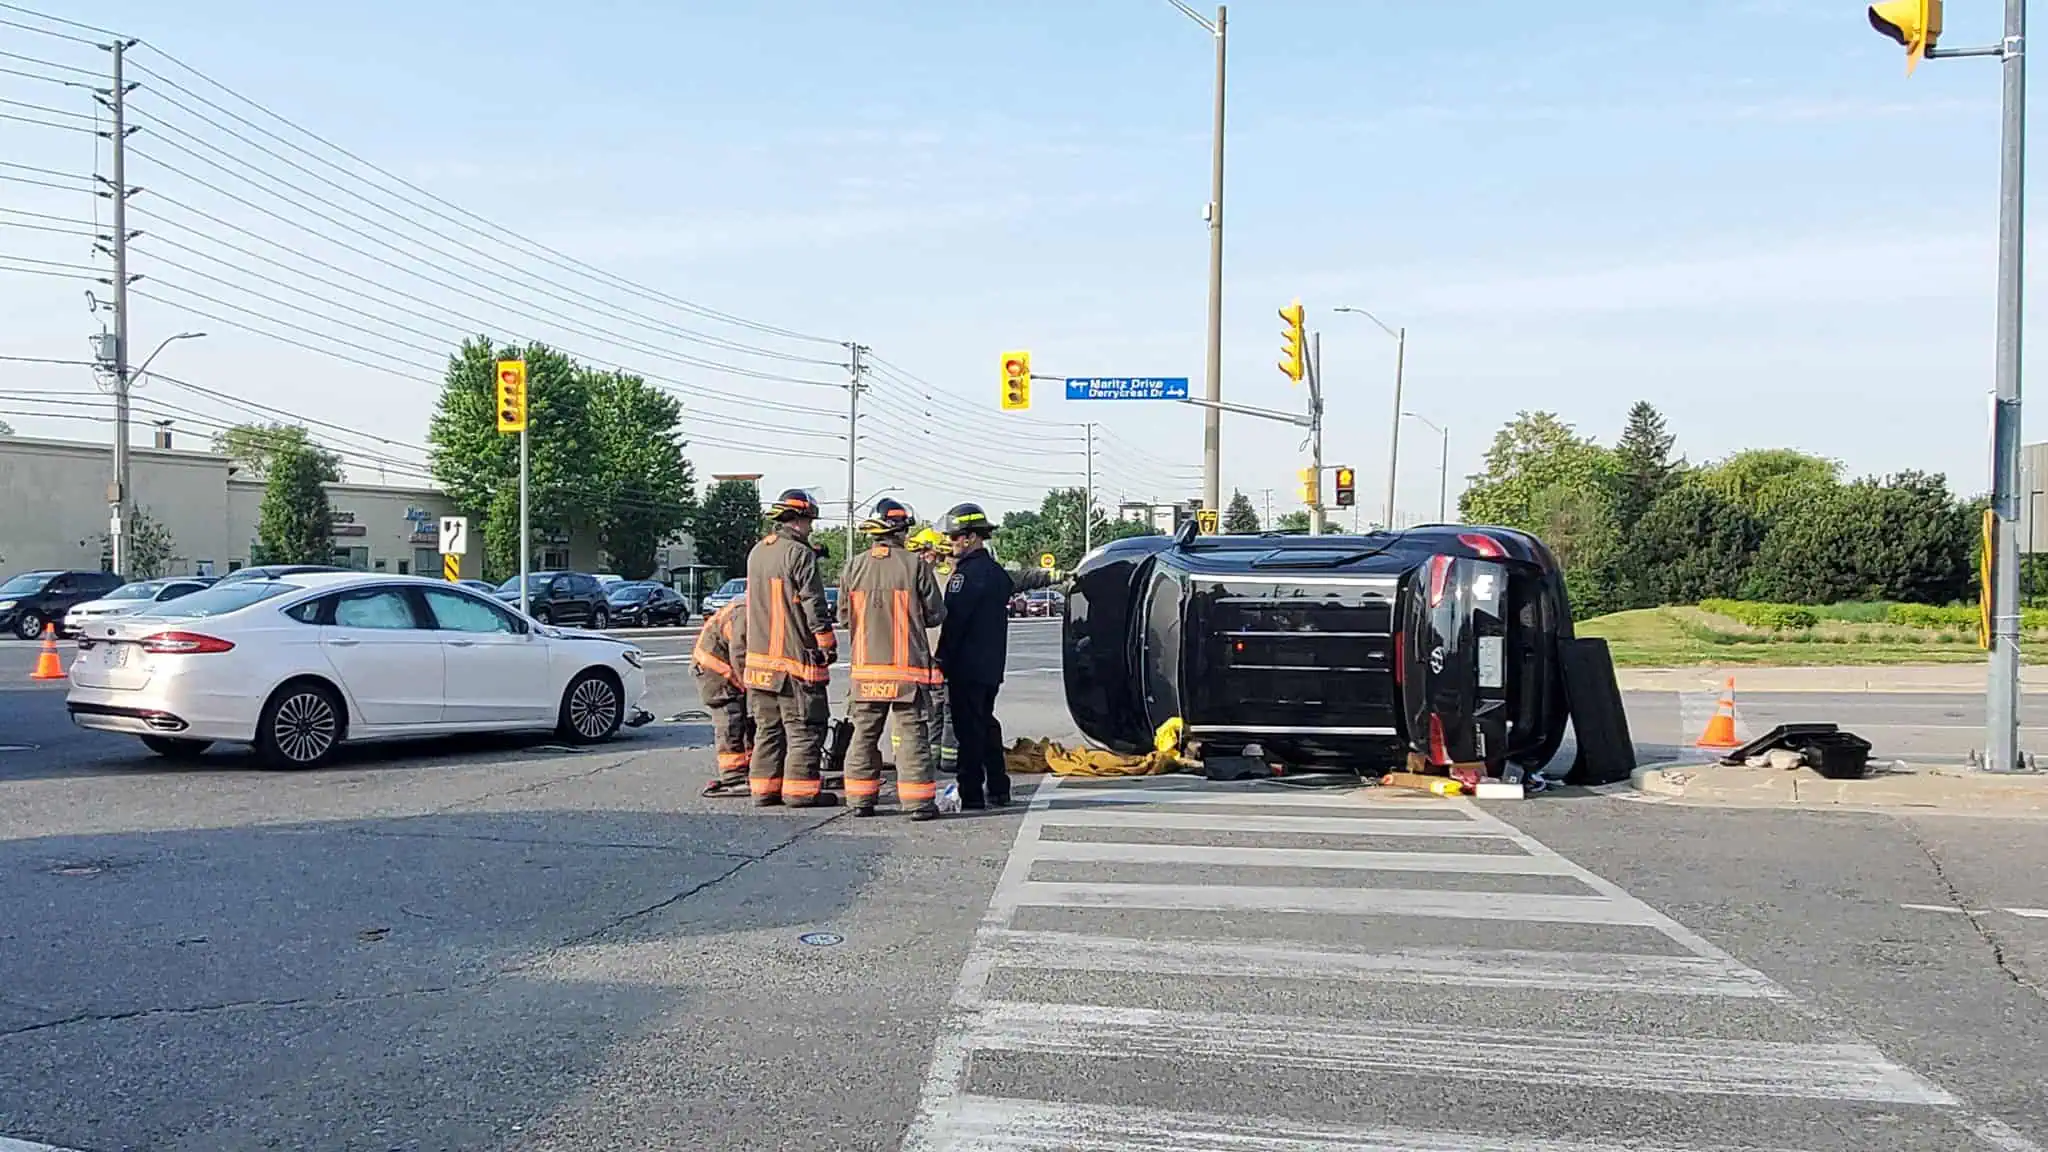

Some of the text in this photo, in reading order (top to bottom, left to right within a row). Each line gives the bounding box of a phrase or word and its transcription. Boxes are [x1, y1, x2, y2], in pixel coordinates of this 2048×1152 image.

[1090, 379, 1164, 390] Maritz Drive
[1088, 389, 1164, 399] Derrycrest Dr
